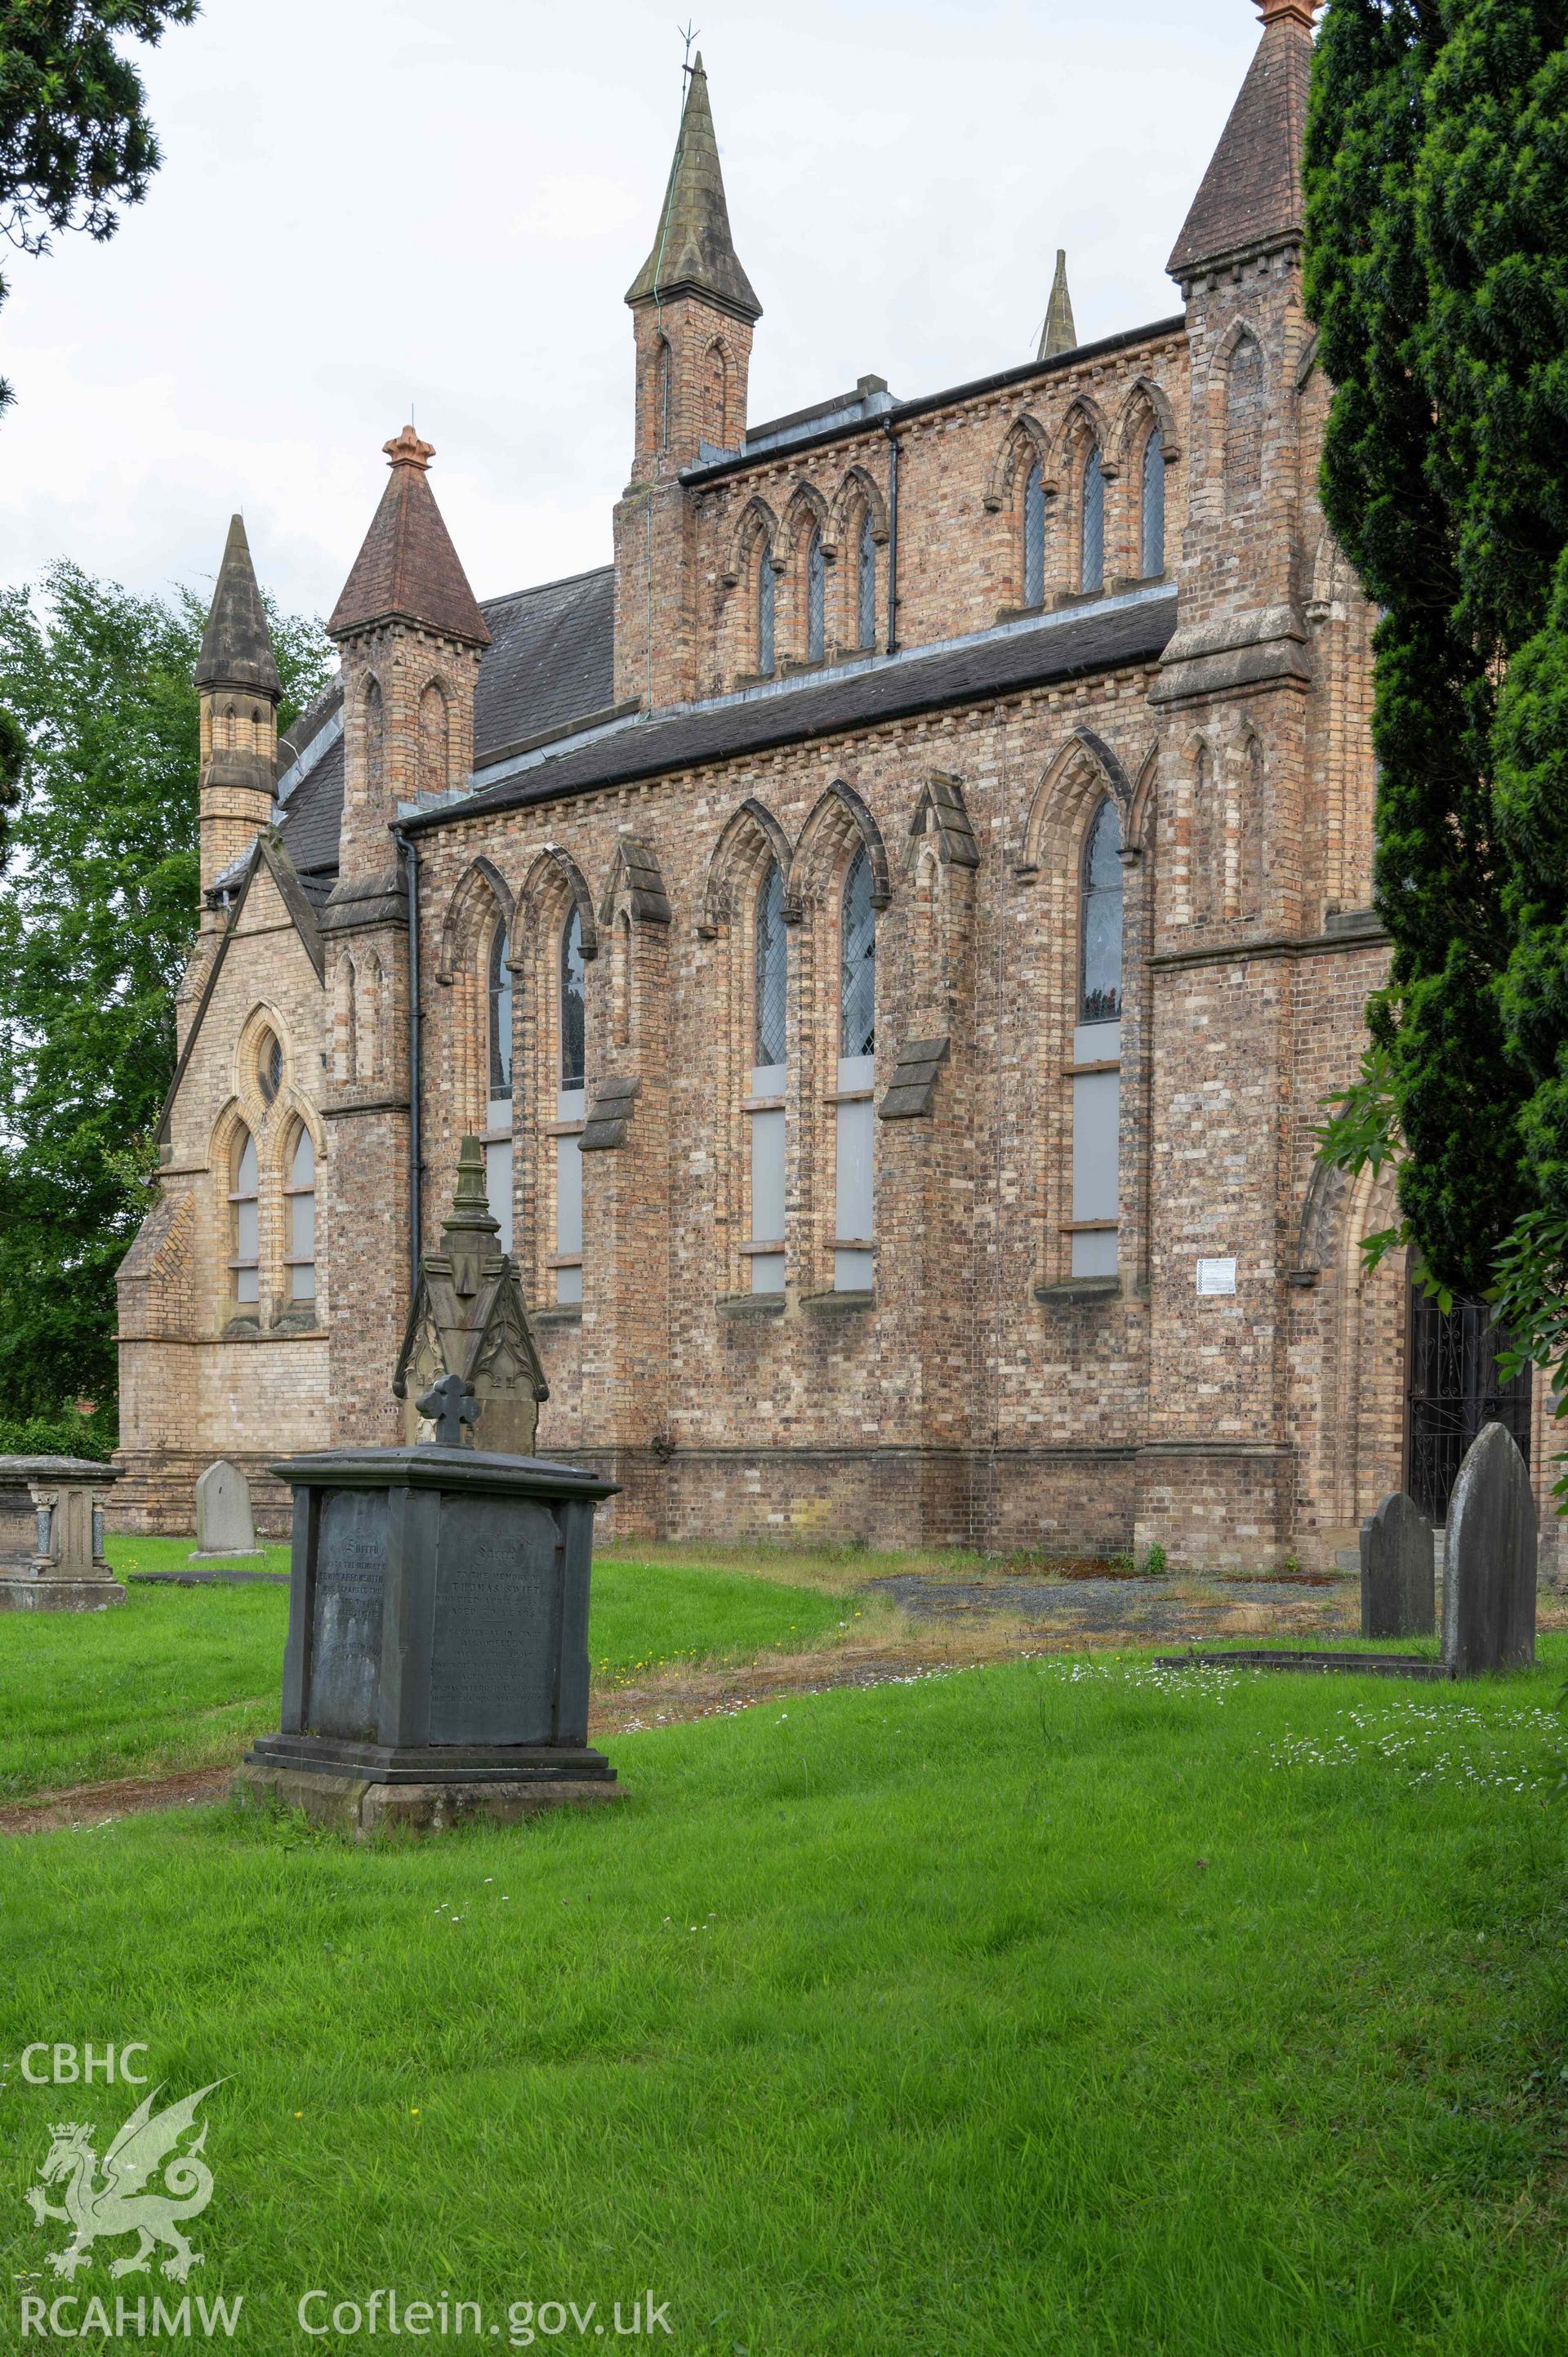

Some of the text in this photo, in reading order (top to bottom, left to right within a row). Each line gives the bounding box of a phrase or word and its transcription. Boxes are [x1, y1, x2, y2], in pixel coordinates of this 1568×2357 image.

[344, 1561, 356, 1569] THE
[357, 1562, 381, 1571] MEMORY
[470, 1571, 490, 1580] THE
[492, 1572, 528, 1582] MEMORY
[451, 1582, 541, 1595] THOMAS SWIFT
[451, 1607, 477, 1616] AGED
[501, 1609, 537, 1618] YEARS
